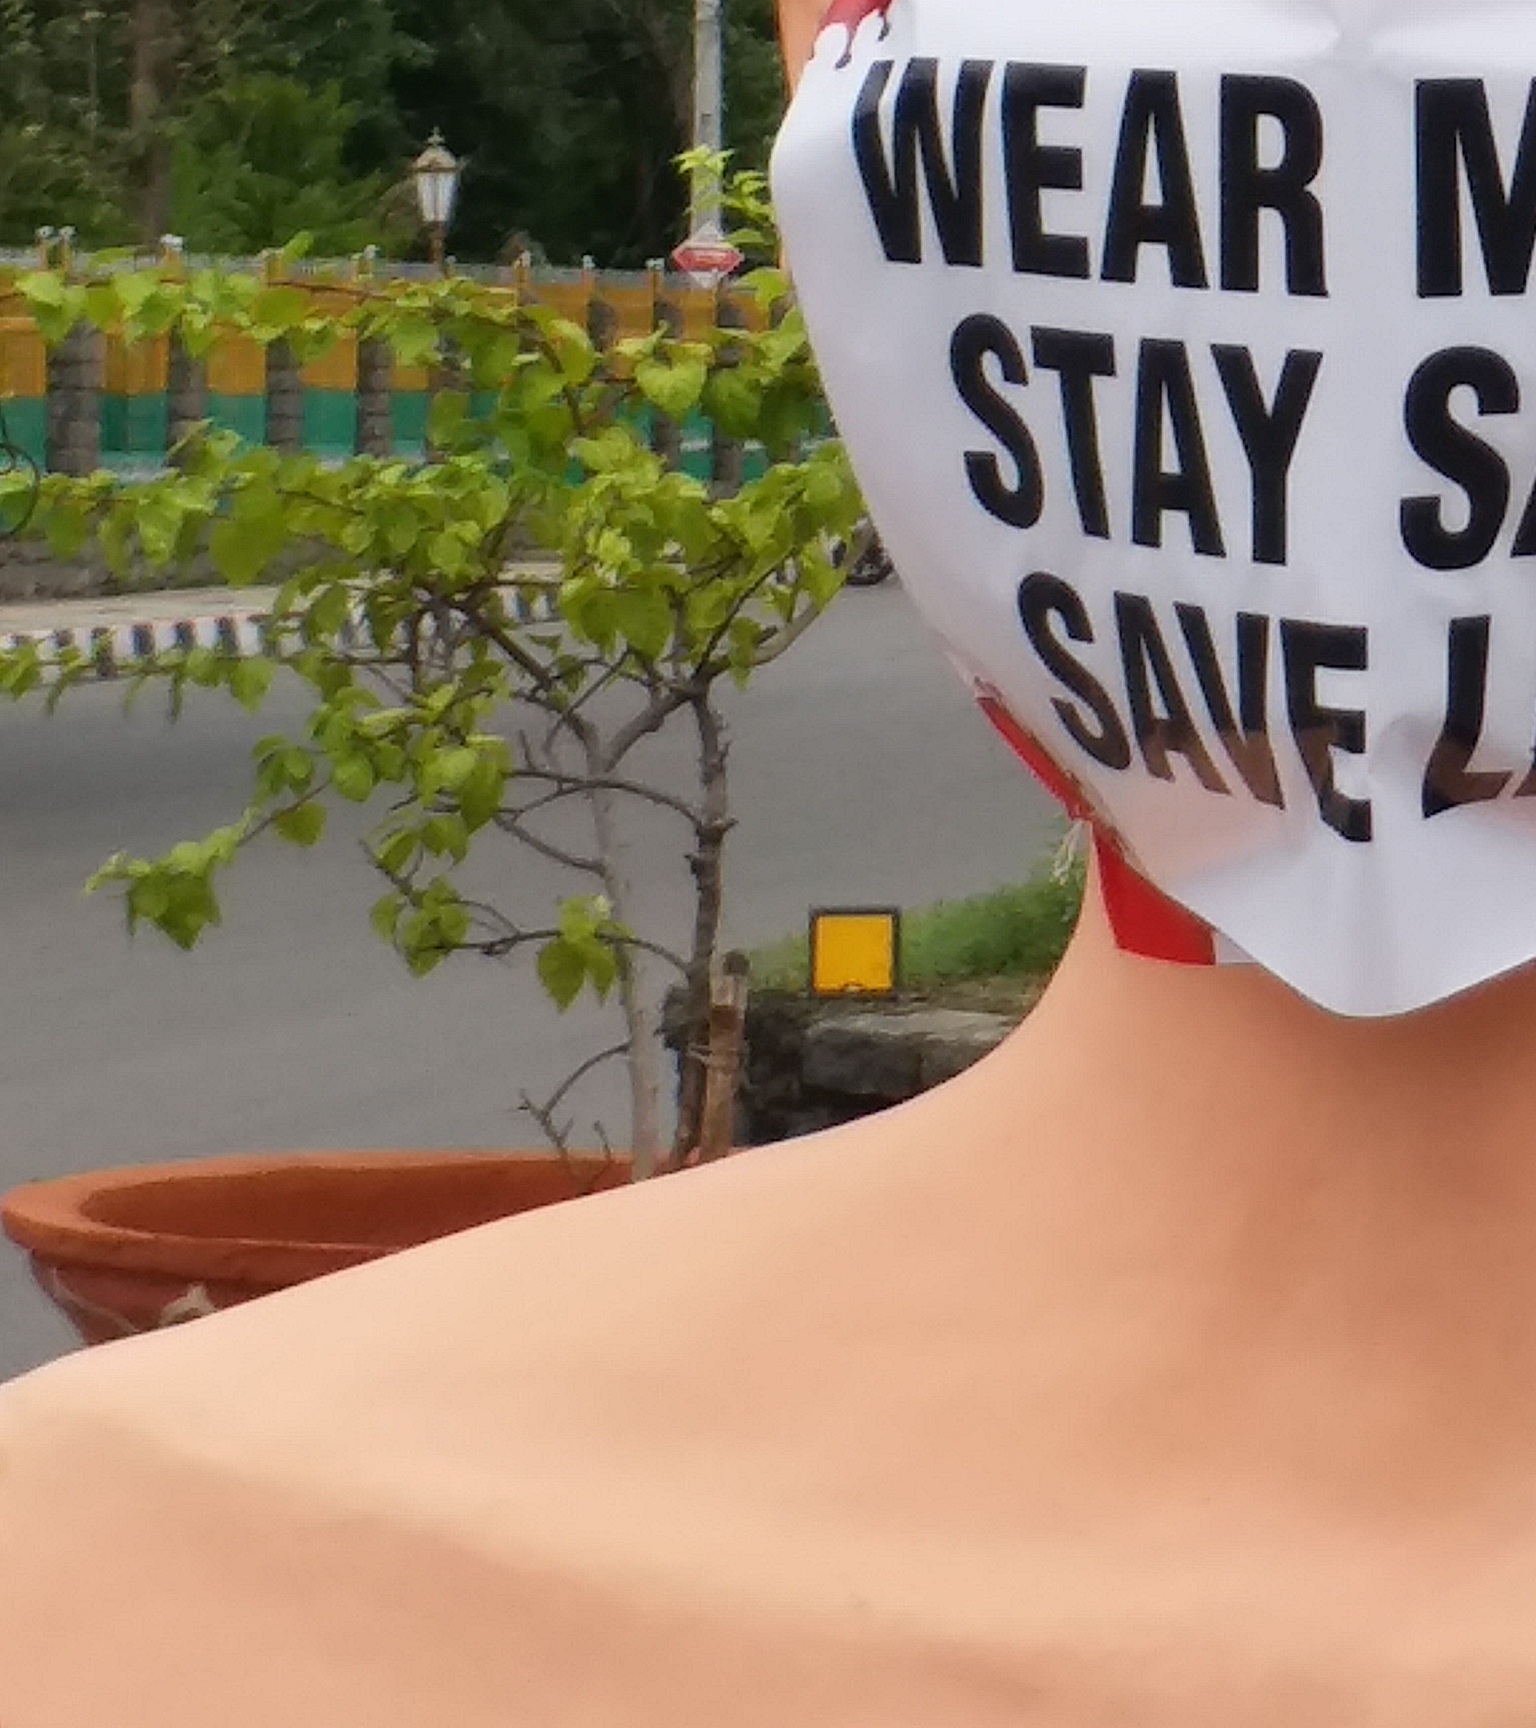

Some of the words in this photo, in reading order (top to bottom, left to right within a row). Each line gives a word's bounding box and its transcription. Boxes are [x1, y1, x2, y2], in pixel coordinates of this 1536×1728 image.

[850, 59, 1330, 299] WEAR
[948, 312, 1324, 566] STAY
[1016, 570, 1374, 844] SAVE
